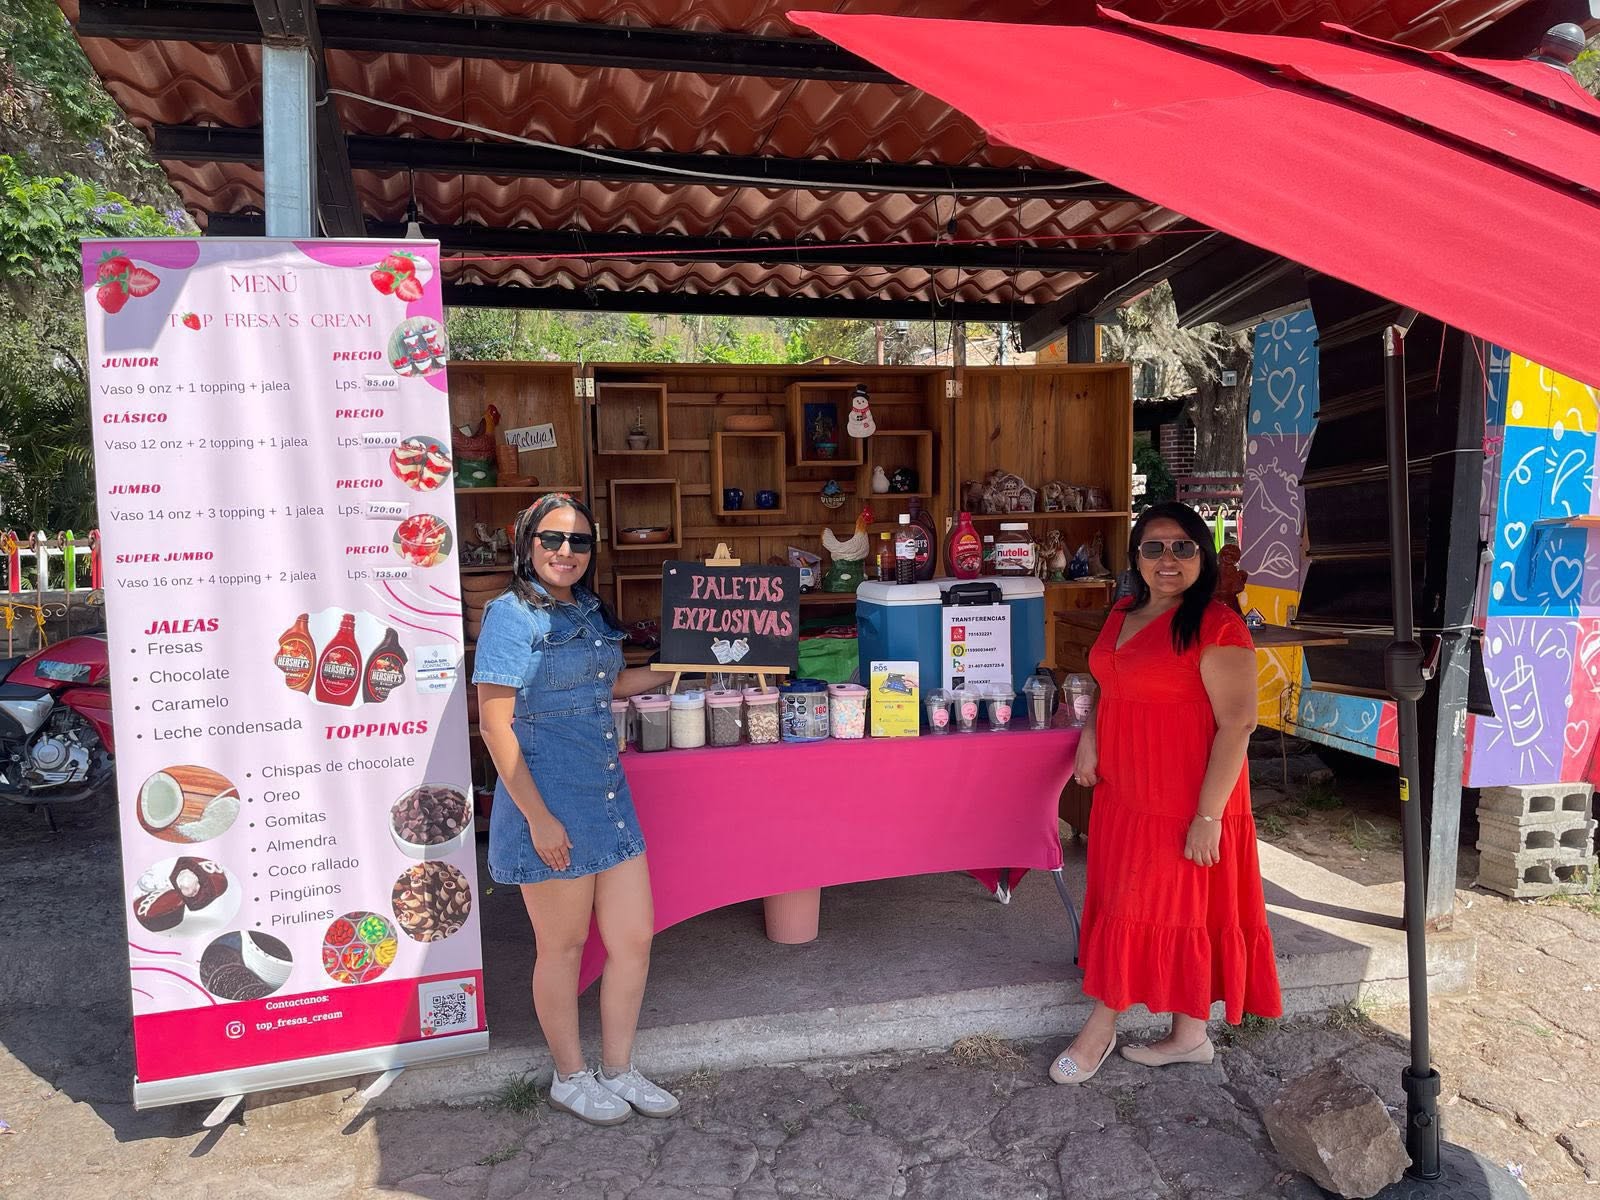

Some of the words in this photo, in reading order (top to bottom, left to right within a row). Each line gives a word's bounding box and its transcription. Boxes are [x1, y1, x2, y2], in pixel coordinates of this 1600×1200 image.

[230, 271, 298, 293] MENÚ
[311, 313, 372, 328] CREAM
[101, 356, 159, 368] JUNIOR
[332, 350, 382, 362] PRECIO
[100, 383, 133, 395] Vaso
[136, 384, 146, 394] 9
[149, 384, 172, 394] onz
[188, 382, 196, 393] 1
[200, 380, 246, 396] topping
[259, 379, 291, 394] jalea
[335, 378, 361, 391] Lps.
[366, 379, 395, 388] 85.00
[103, 411, 168, 424] CLÁSICO
[335, 407, 385, 419] PRECIO
[104, 439, 137, 450] Vaso
[141, 438, 156, 450] 12
[160, 440, 183, 449] onz
[199, 437, 206, 448] 2
[210, 435, 254, 451] topping
[270, 436, 277, 447] 1
[280, 435, 308, 449] jalea
[337, 435, 362, 448] Lps.
[363, 436, 398, 446] 100.00
[108, 484, 161, 495] JUMBO
[336, 478, 384, 489] PRECIO
[110, 510, 144, 522] Vaso
[148, 509, 164, 521] 14
[168, 511, 192, 520] onz
[208, 508, 217, 519] 3
[220, 506, 265, 522] topping
[285, 506, 292, 516] 1
[295, 504, 324, 519] jalea
[338, 504, 363, 517] Lps.
[369, 506, 403, 516] 120.00
[116, 553, 160, 564] SUPER
[163, 551, 214, 562] JUMBO
[345, 545, 390, 555] PRECIO
[997, 547, 1029, 557] nutella
[117, 578, 149, 589] Vaso
[153, 576, 168, 587] 16
[171, 577, 193, 587] onz
[208, 574, 216, 585] 4
[219, 573, 262, 587] topping
[280, 572, 287, 582] 2
[289, 570, 317, 585] jalea
[347, 569, 370, 581] Lps.
[375, 571, 408, 579] 135.00
[690, 575, 784, 602] PALETAS
[144, 618, 219, 635] JALEAS
[672, 607, 793, 636] EXPLOSIVAS
[951, 615, 1006, 623] TRANSFERENCIAS
[148, 641, 203, 656] Fresas
[277, 656, 310, 669] HERSHEY'S
[149, 667, 230, 684] Chocolate
[324, 664, 356, 677] HERSHEY'S
[371, 670, 402, 683] HERSHEY'S
[151, 695, 229, 713] Caramelo
[154, 723, 203, 742] Leche
[208, 717, 302, 736] condensada
[325, 720, 428, 740] TOPPINGS
[262, 761, 322, 779] Chispas
[325, 759, 343, 773] de
[347, 755, 415, 771] chocolate
[263, 789, 300, 804] Oreo
[265, 810, 327, 828] Gomitas
[266, 834, 337, 853] Almendra
[268, 862, 307, 877] Coco
[311, 857, 359, 873] rallado
[270, 882, 341, 905] Pingüinos
[271, 908, 334, 927] Pirulines
[265, 995, 330, 1010] Contactanos:
[255, 1011, 343, 1030] top_fresas_cream
